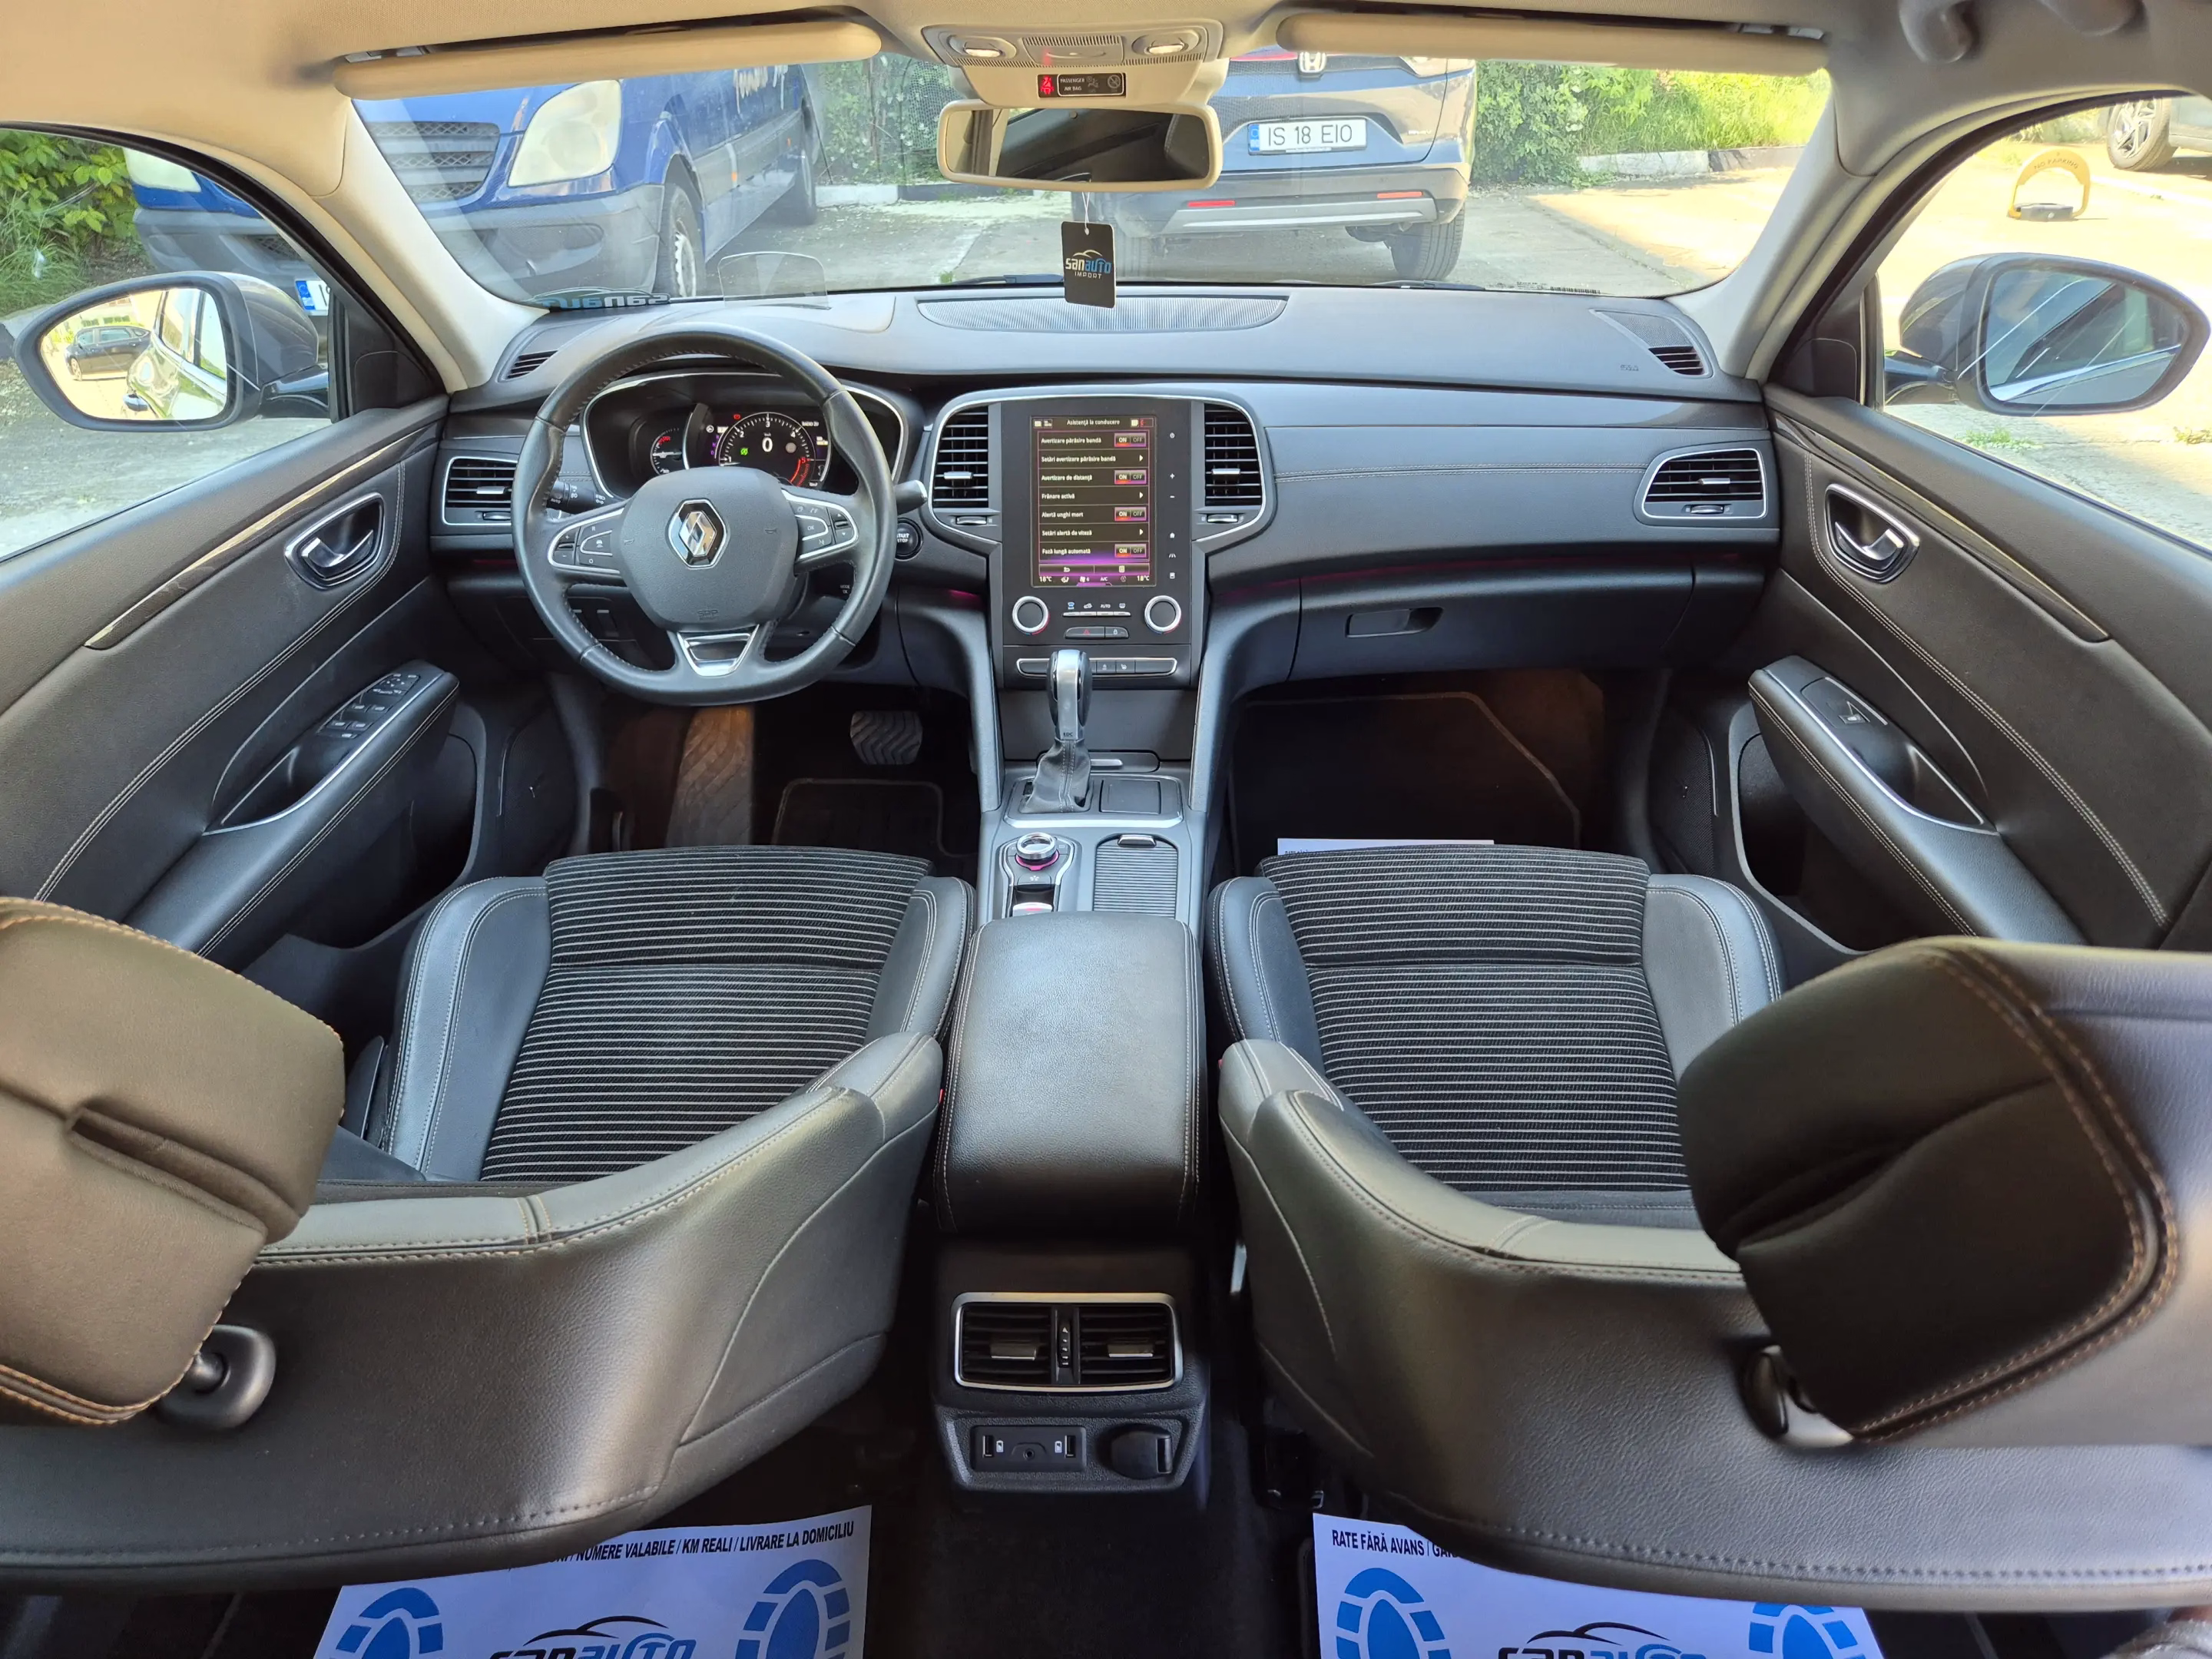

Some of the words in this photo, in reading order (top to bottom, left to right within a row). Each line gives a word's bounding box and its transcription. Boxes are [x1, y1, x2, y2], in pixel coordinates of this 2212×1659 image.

[1268, 127, 1285, 146] IS
[1294, 126, 1311, 144] 18
[1321, 124, 1353, 144] EIO
[762, 437, 773, 452] 0
[576, 1544, 623, 1561] NUMERE
[625, 1539, 676, 1558] VALABILE
[682, 1538, 699, 1554] KM
[701, 1537, 733, 1553] REALI
[740, 1533, 785, 1551] LIVRARE
[786, 1533, 800, 1548] LA
[802, 1521, 854, 1545] DOMICILIU
[1332, 1529, 1359, 1549] RATE
[1360, 1531, 1389, 1553] FĂRĂ
[1390, 1537, 1425, 1556] AVANS
